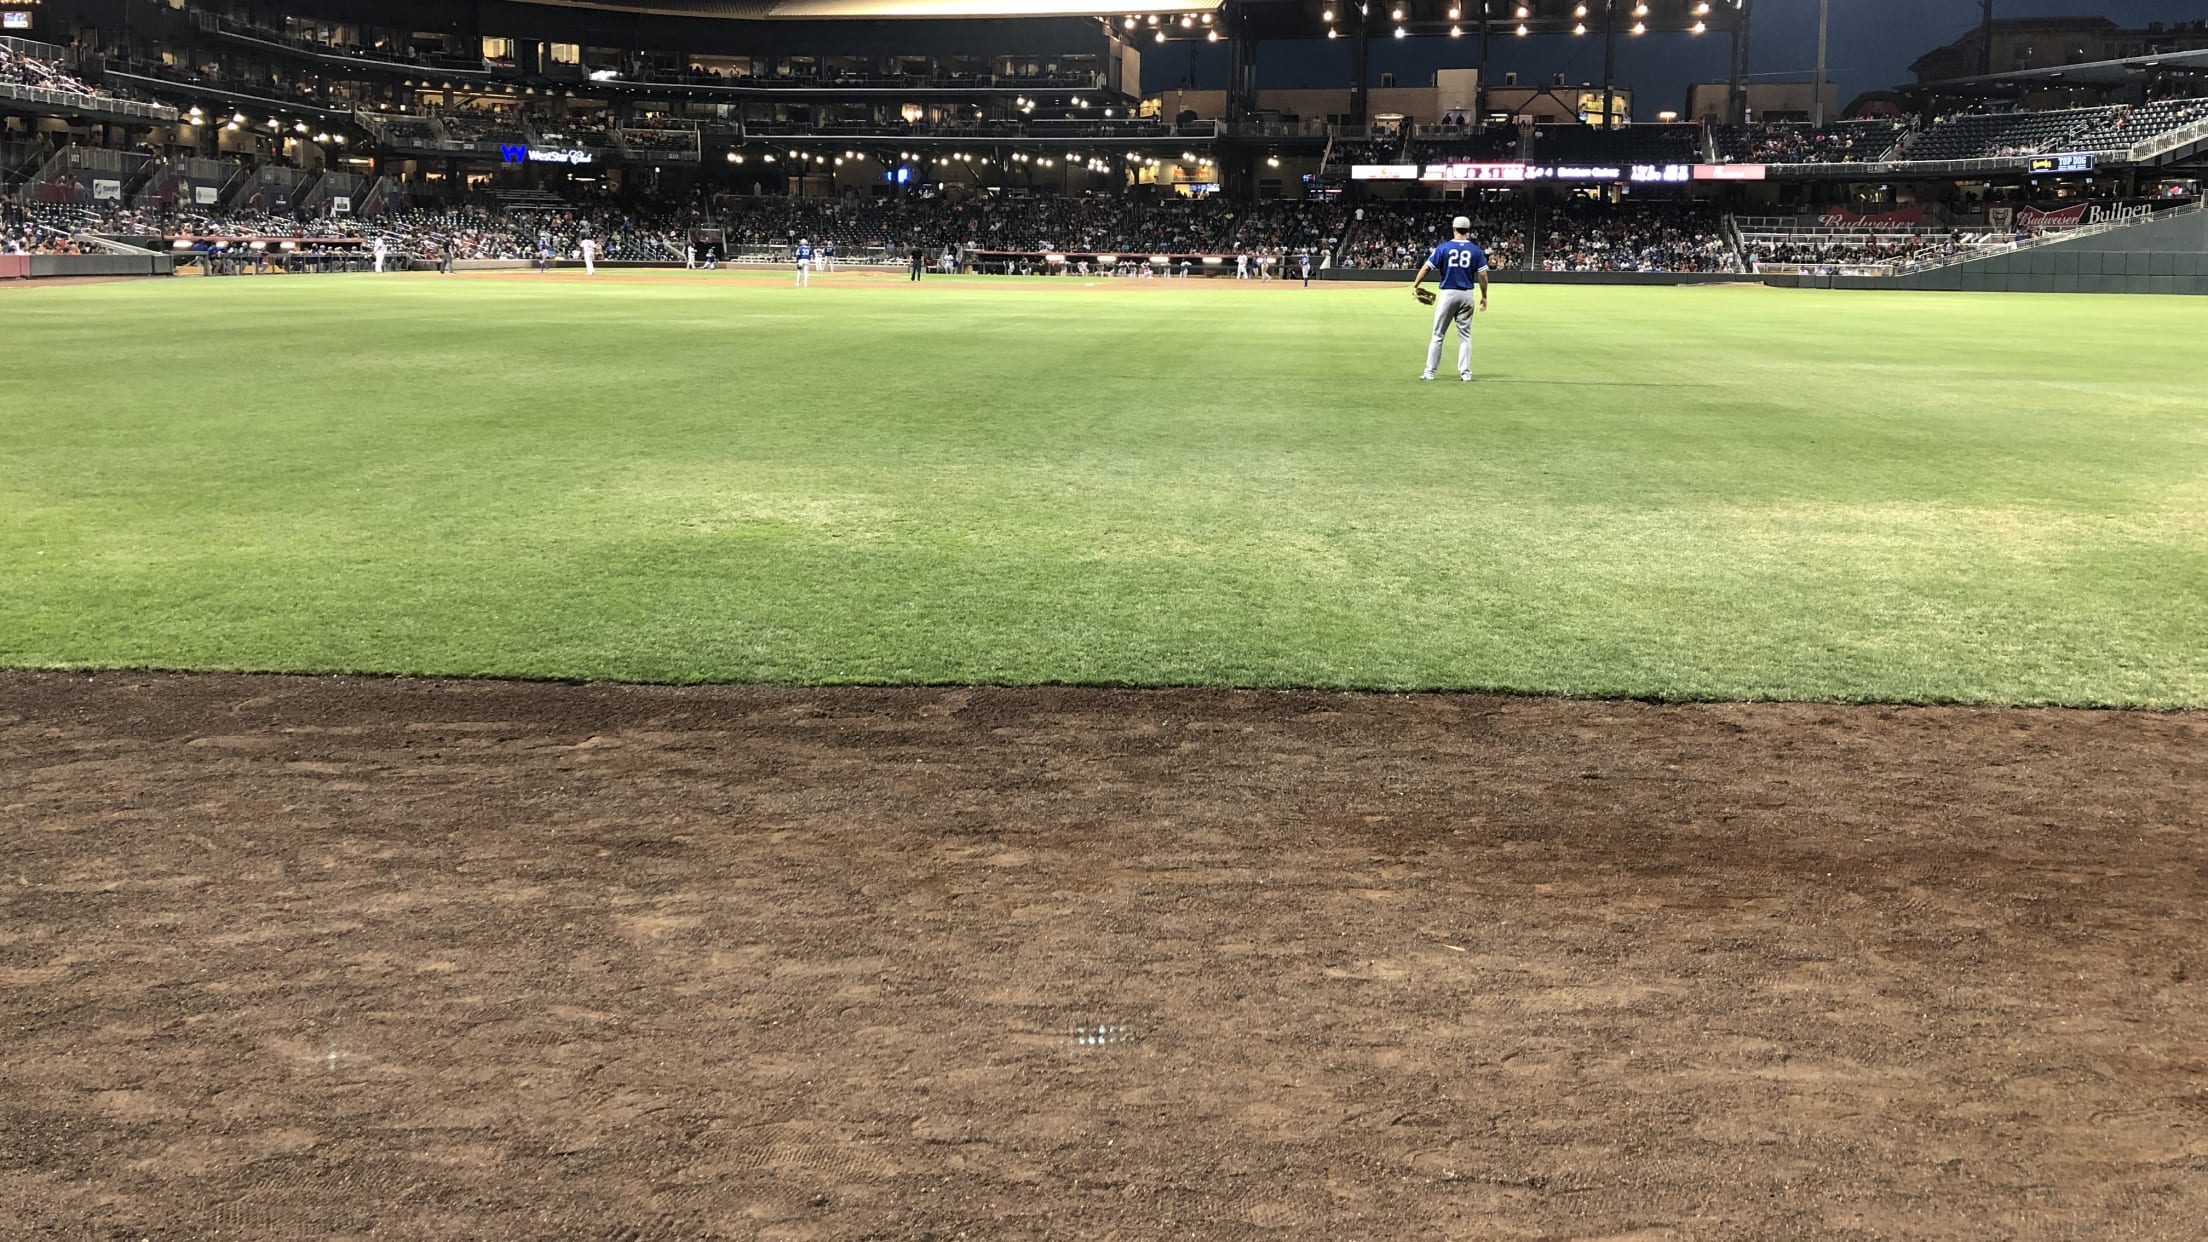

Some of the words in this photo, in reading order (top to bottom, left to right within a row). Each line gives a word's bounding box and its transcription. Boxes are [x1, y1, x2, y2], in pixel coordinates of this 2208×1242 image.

[2058, 156, 2073, 167] TOP
[2073, 155, 2087, 165] DOG
[1817, 213, 1916, 230] Budweiser
[2016, 211, 2080, 228] Budweiser
[2087, 201, 2153, 225] Bullpen
[1448, 248, 1472, 268] 28
